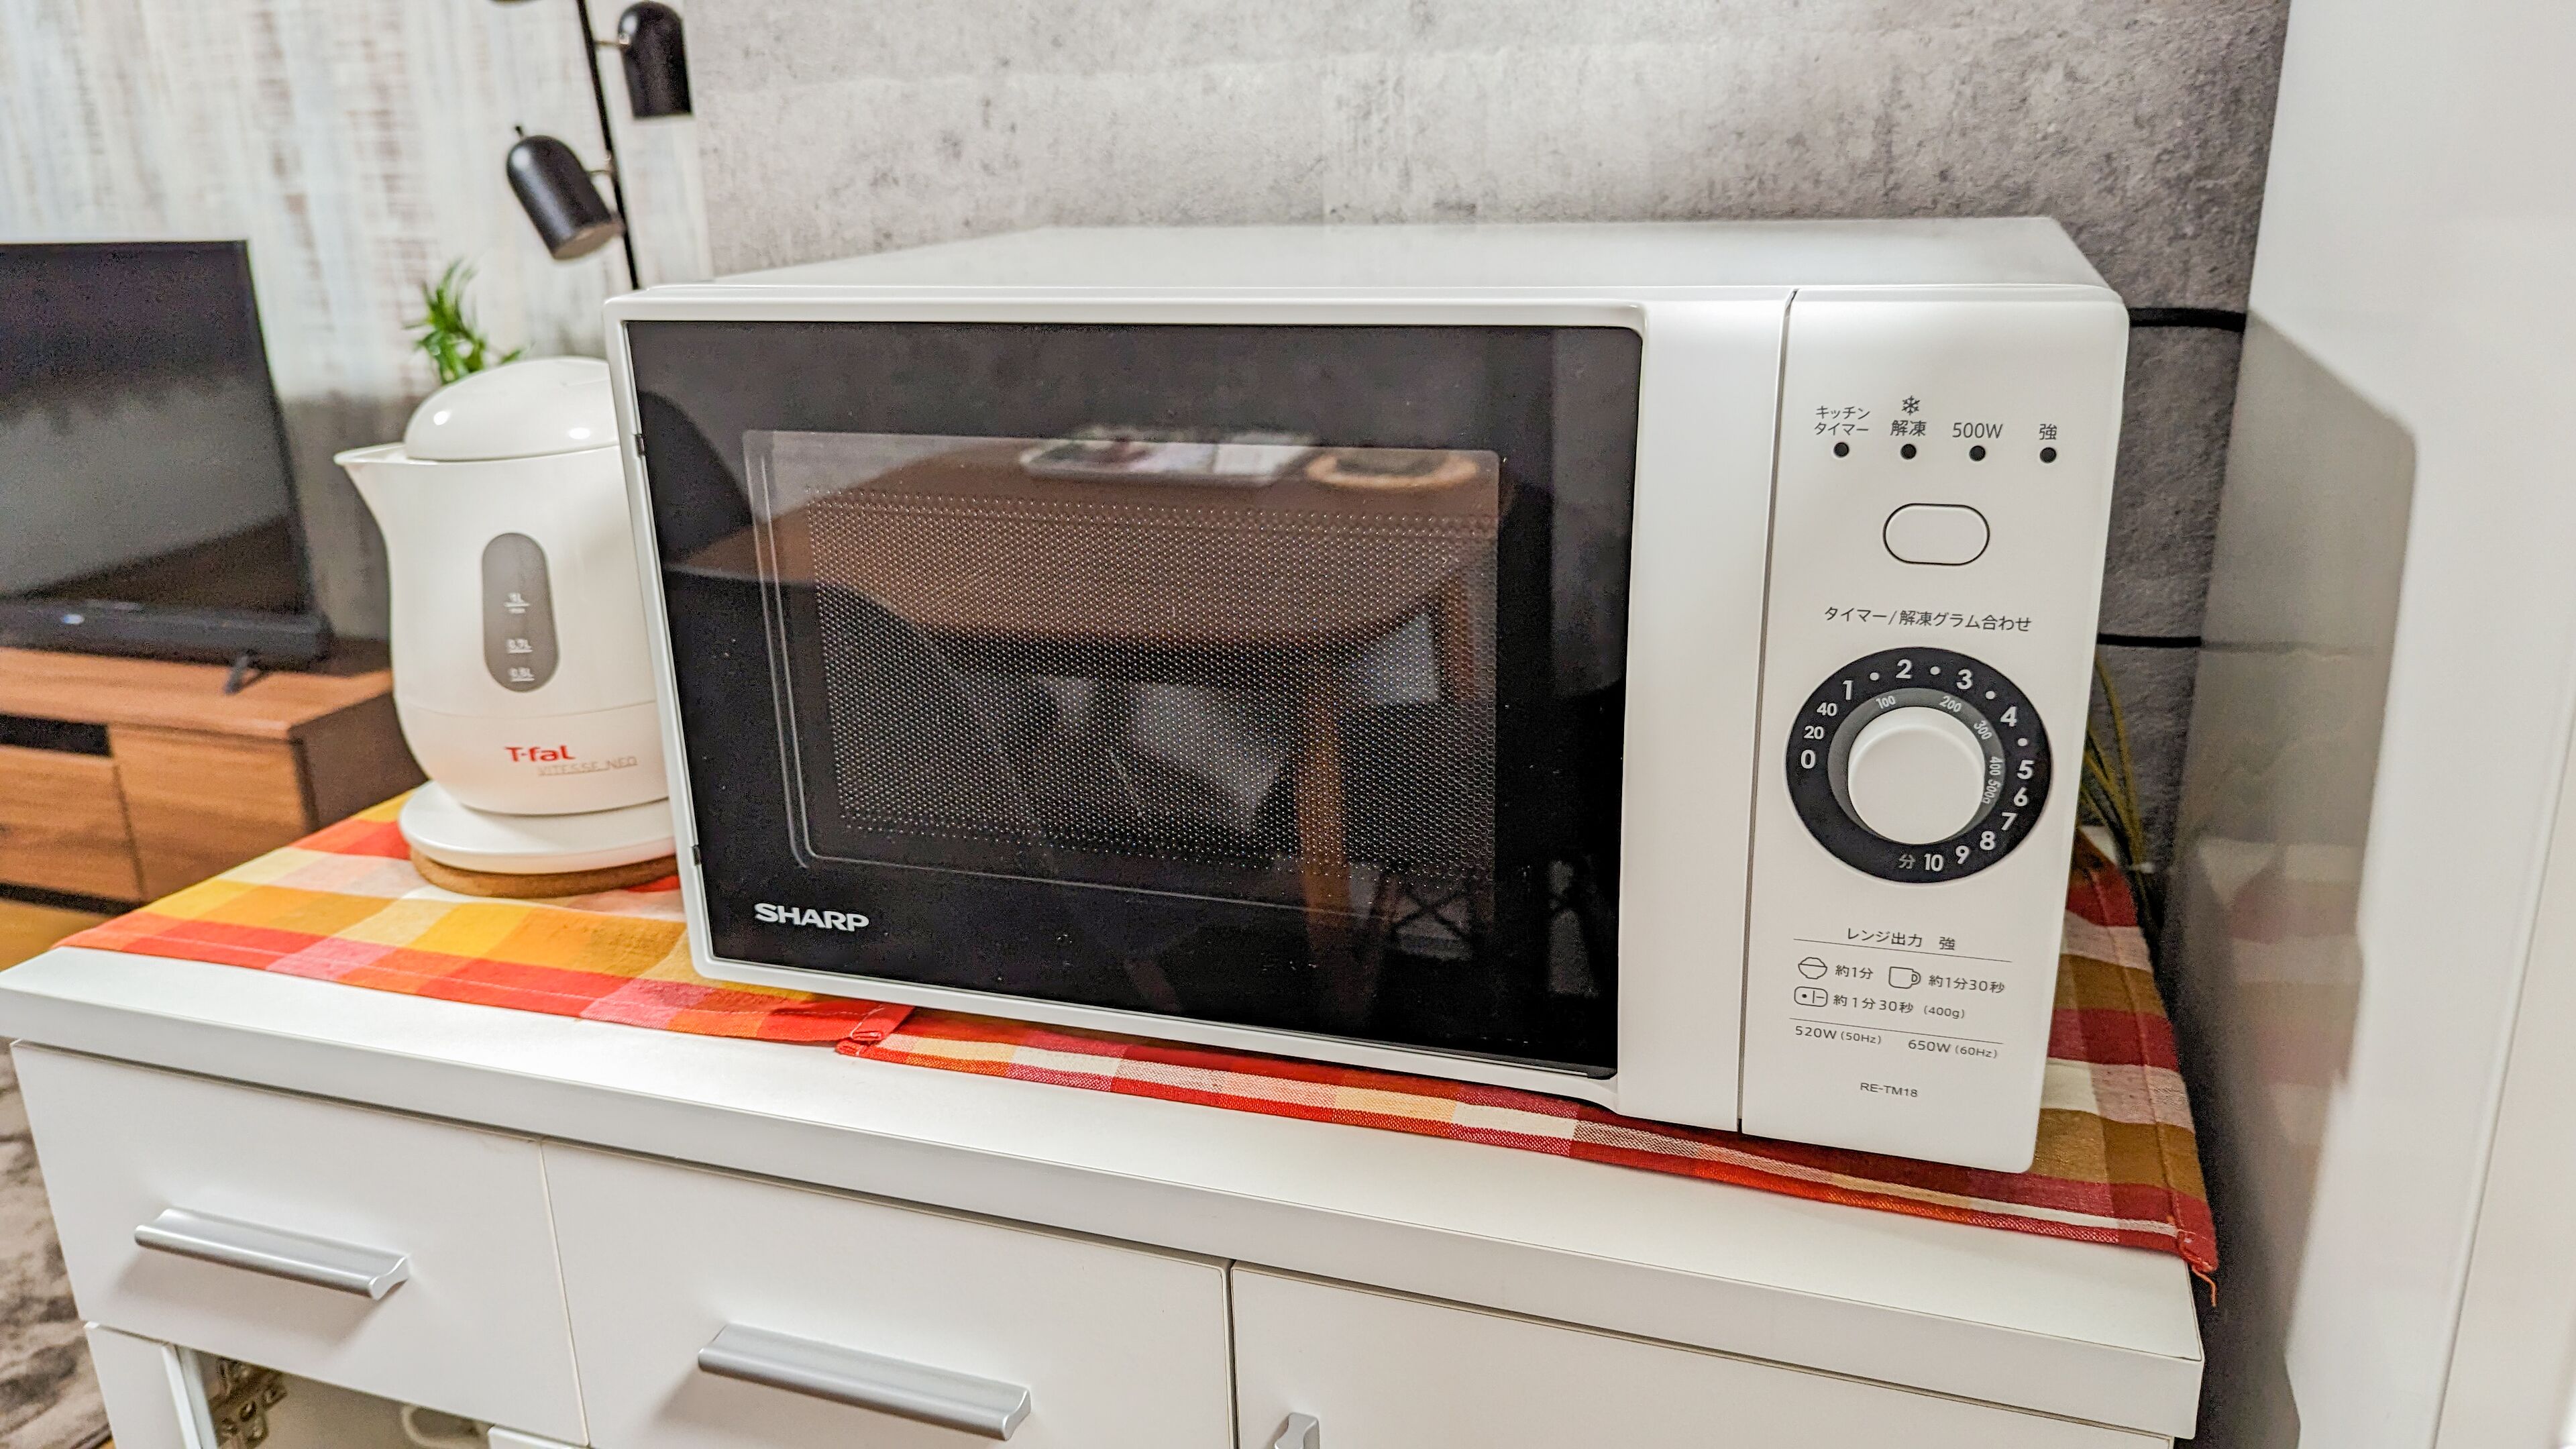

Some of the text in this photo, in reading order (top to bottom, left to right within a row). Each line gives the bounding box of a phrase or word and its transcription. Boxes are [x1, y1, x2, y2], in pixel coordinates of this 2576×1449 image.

[1815, 405, 1870, 420] キッチン
[1814, 421, 1869, 436] タイマー
[1890, 420, 1927, 437] 解凍
[1952, 423, 2003, 439] 500W
[2039, 423, 2057, 440] 強
[1896, 659, 1912, 679] 2
[1956, 669, 1973, 690] 3
[1843, 680, 1853, 700] 1
[1817, 703, 1837, 717] 40
[1876, 695, 1896, 709] 100
[1939, 696, 1962, 712] 200
[2000, 706, 2017, 727] 4
[1804, 725, 1824, 740] 20
[1974, 720, 1992, 740] 300
[1801, 749, 1816, 769] 0
[1989, 756, 2003, 776] 400
[2017, 759, 2035, 780] 5
[2013, 786, 2029, 807] 6
[2001, 812, 2018, 831] 7
[1980, 830, 1996, 851] 8
[1898, 854, 1916, 869] 分
[1924, 853, 1944, 872] 10
[1955, 845, 1970, 865] 9
[753, 902, 870, 932] SHARP
[1847, 928, 1955, 951] レンジ出力 強
[1835, 964, 1874, 980] 約1分
[1928, 974, 2005, 994] 約1分30秒
[1833, 994, 1966, 1019] 約1分30秒 (400g)
[1795, 1025, 1882, 1044] 520W (50Hz)
[1908, 1039, 1998, 1059] 650W (60Hz)
[1860, 1081, 1919, 1097] RE-TM18
